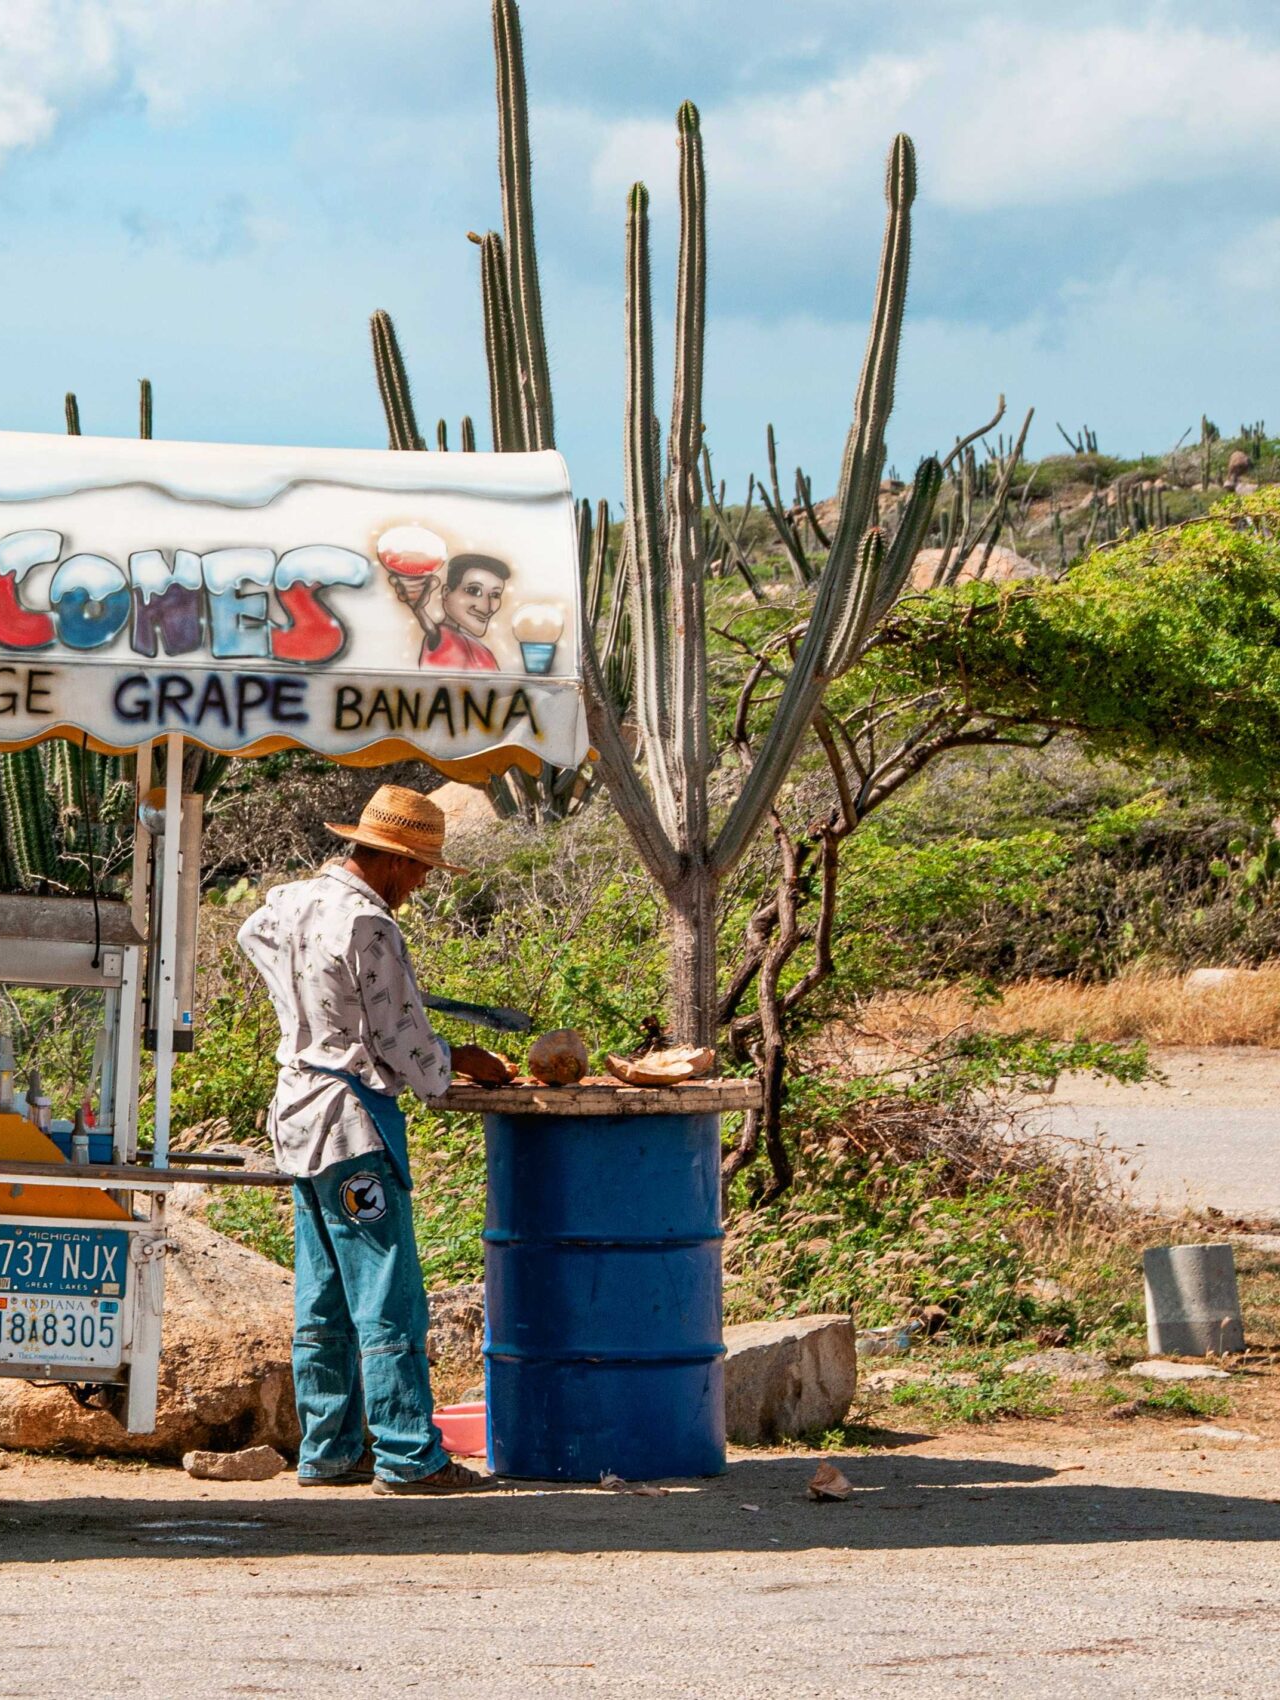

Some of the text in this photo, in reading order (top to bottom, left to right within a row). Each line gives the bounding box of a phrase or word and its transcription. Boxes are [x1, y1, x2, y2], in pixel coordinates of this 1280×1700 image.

[113, 674, 310, 733] GRAPE
[333, 684, 540, 738] BANANA
[28, 1231, 91, 1242] MICHIGAN
[62, 1243, 118, 1281] NJX
[24, 1281, 89, 1291] GREAT LAKES
[23, 1298, 86, 1311] INDIANA
